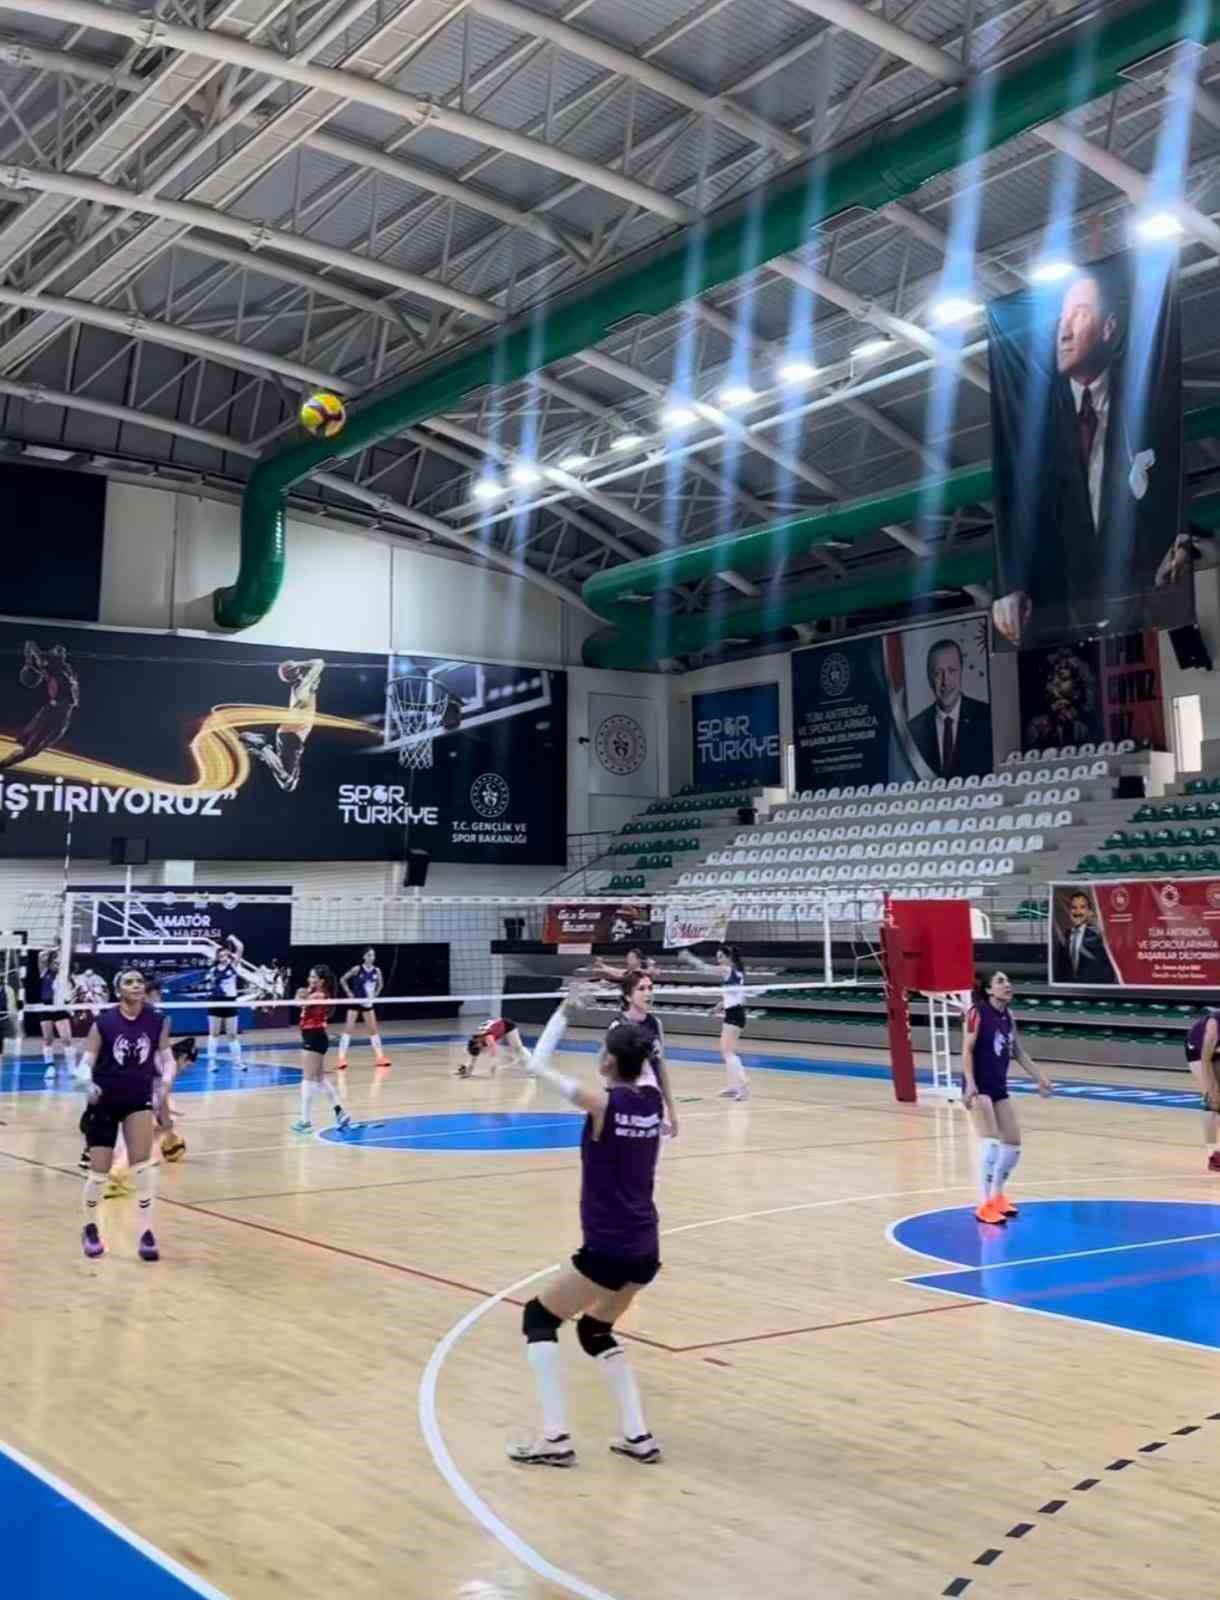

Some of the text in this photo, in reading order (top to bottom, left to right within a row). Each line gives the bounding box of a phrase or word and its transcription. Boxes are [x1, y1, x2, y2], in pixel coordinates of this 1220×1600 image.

[697, 716, 750, 741] SPOR
[697, 735, 779, 763] TÜRKİYE
[338, 784, 404, 804] SPOR
[338, 802, 439, 825] TÜRKİYE
[452, 833, 476, 843] SPOR
